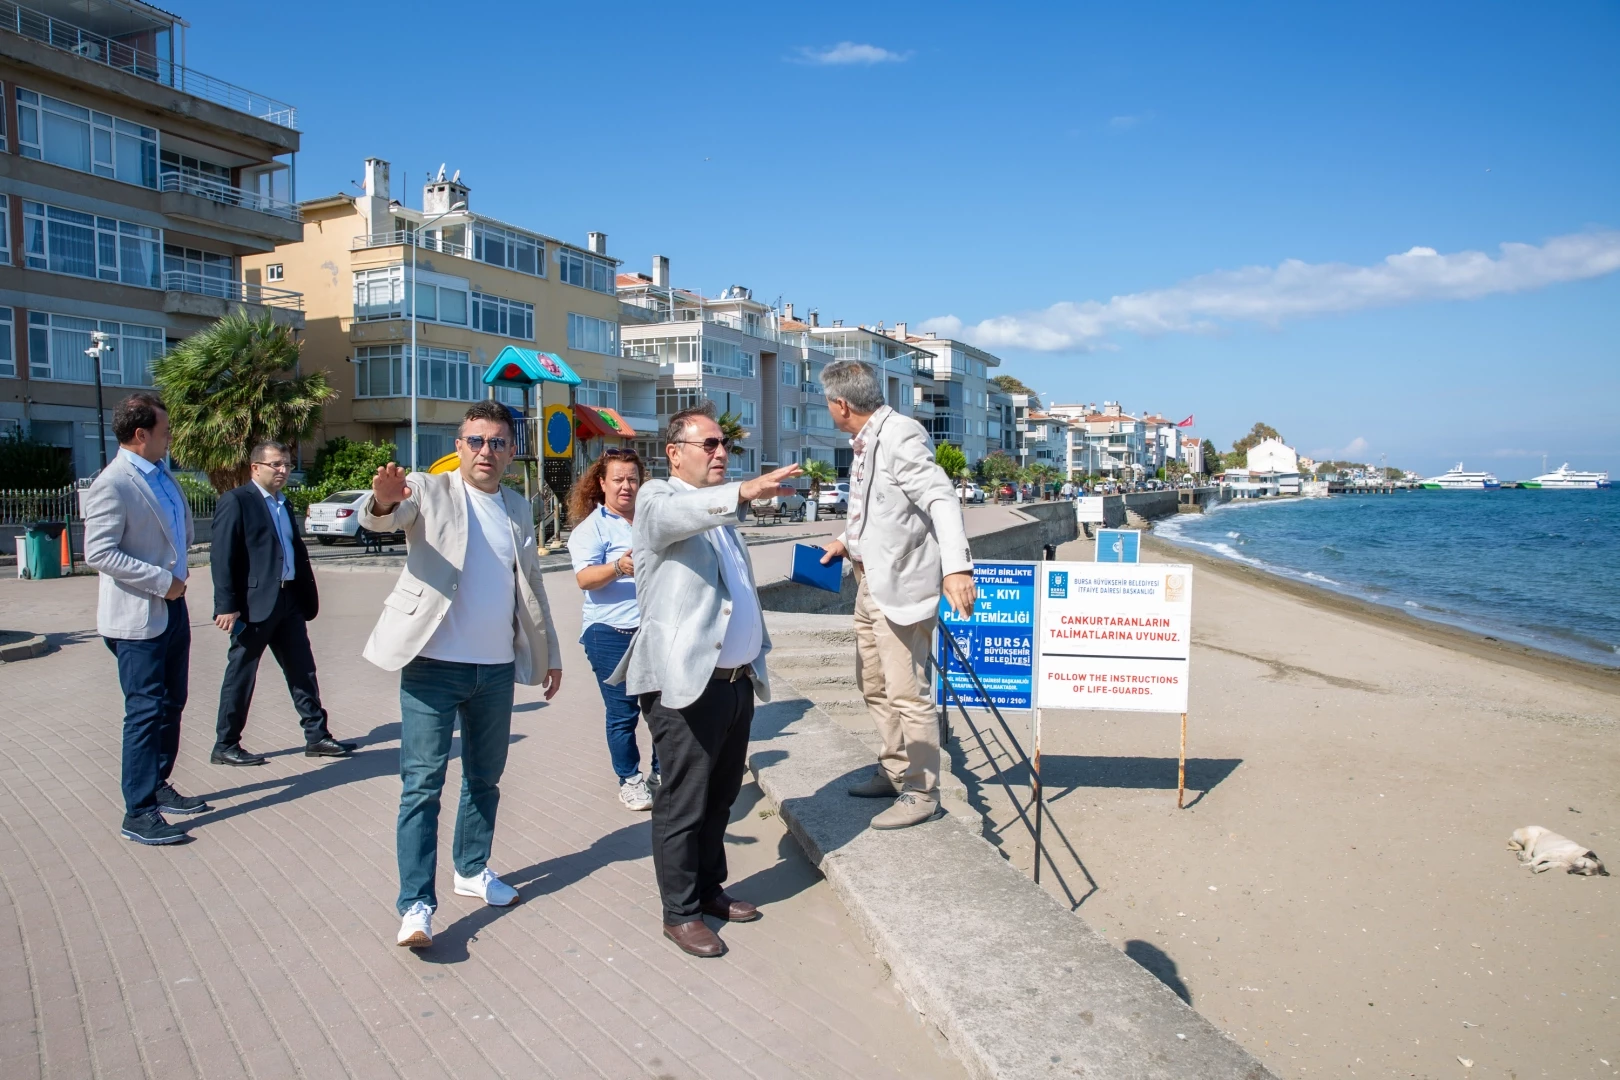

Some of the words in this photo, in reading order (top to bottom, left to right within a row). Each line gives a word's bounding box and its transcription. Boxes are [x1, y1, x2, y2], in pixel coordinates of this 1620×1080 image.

[998, 568, 1032, 576] BİRLİKTE
[996, 589, 1020, 600] KIYI
[974, 610, 1030, 624] TEMİZLİĞİ
[1061, 616, 1170, 627] CANKURTARANLARIN
[1050, 628, 1133, 640] TALİMATLARINA
[1136, 632, 1180, 642] UYUNUZ.
[984, 637, 1030, 648] BURSA
[1048, 672, 1087, 681] FOLLOW
[1110, 675, 1178, 684] INSTRUCTIONS
[1088, 686, 1152, 695] LIFE-GUARDS.
